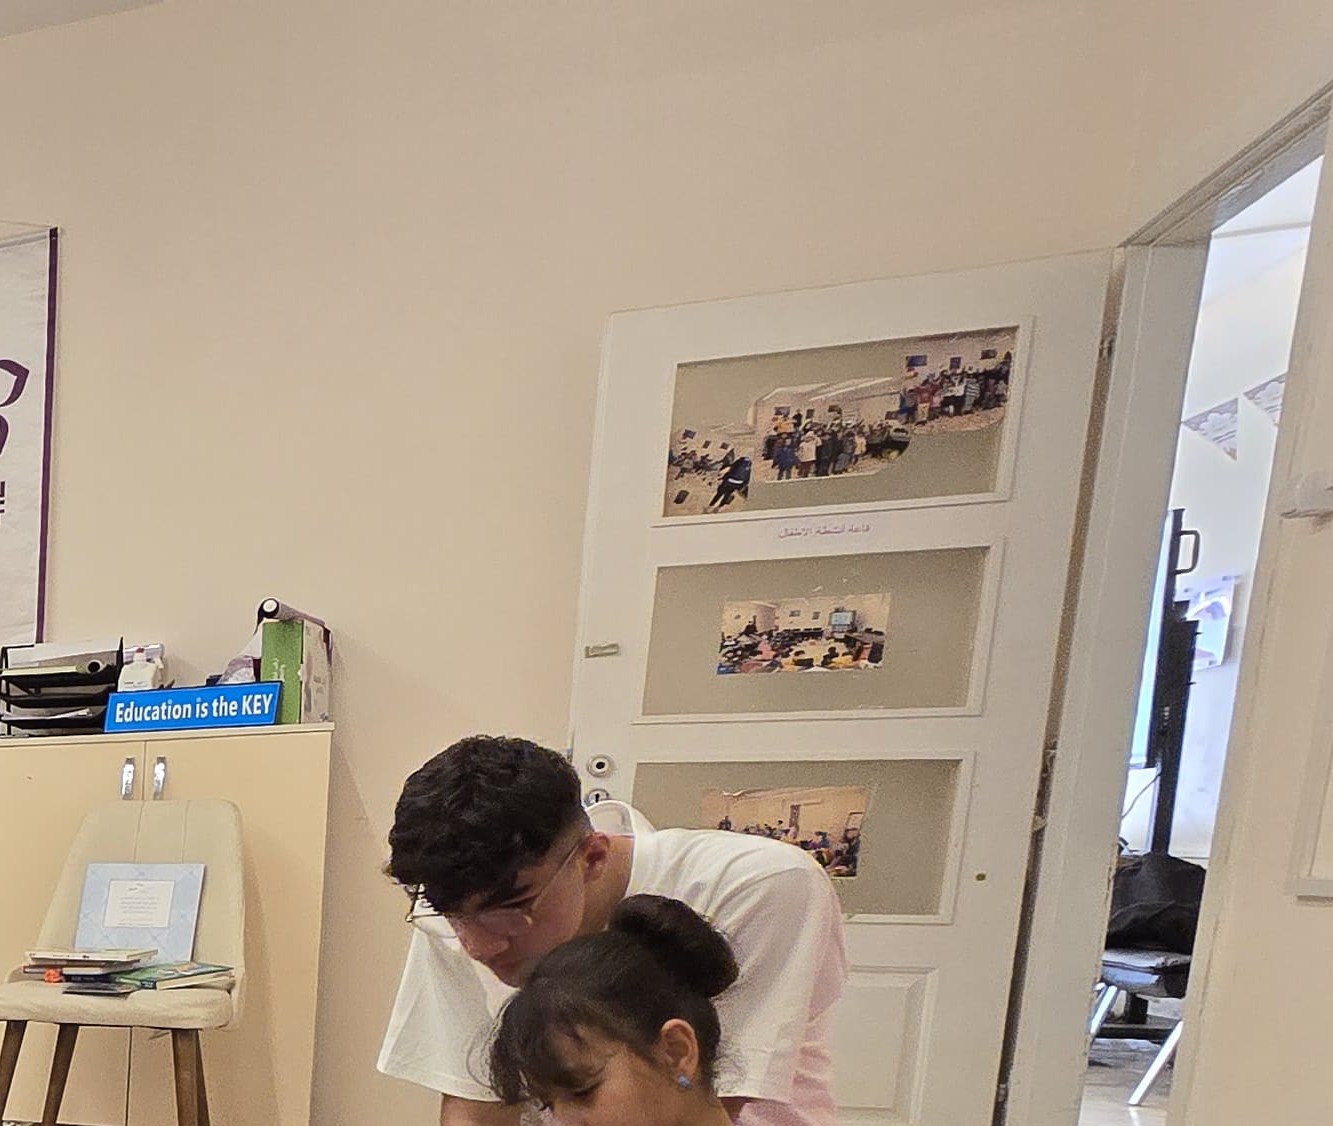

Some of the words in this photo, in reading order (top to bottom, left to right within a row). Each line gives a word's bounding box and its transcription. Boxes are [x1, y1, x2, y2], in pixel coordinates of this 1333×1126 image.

[114, 699, 192, 723] Education
[195, 696, 208, 718] is
[211, 696, 238, 718] the
[241, 693, 273, 716] KEY
